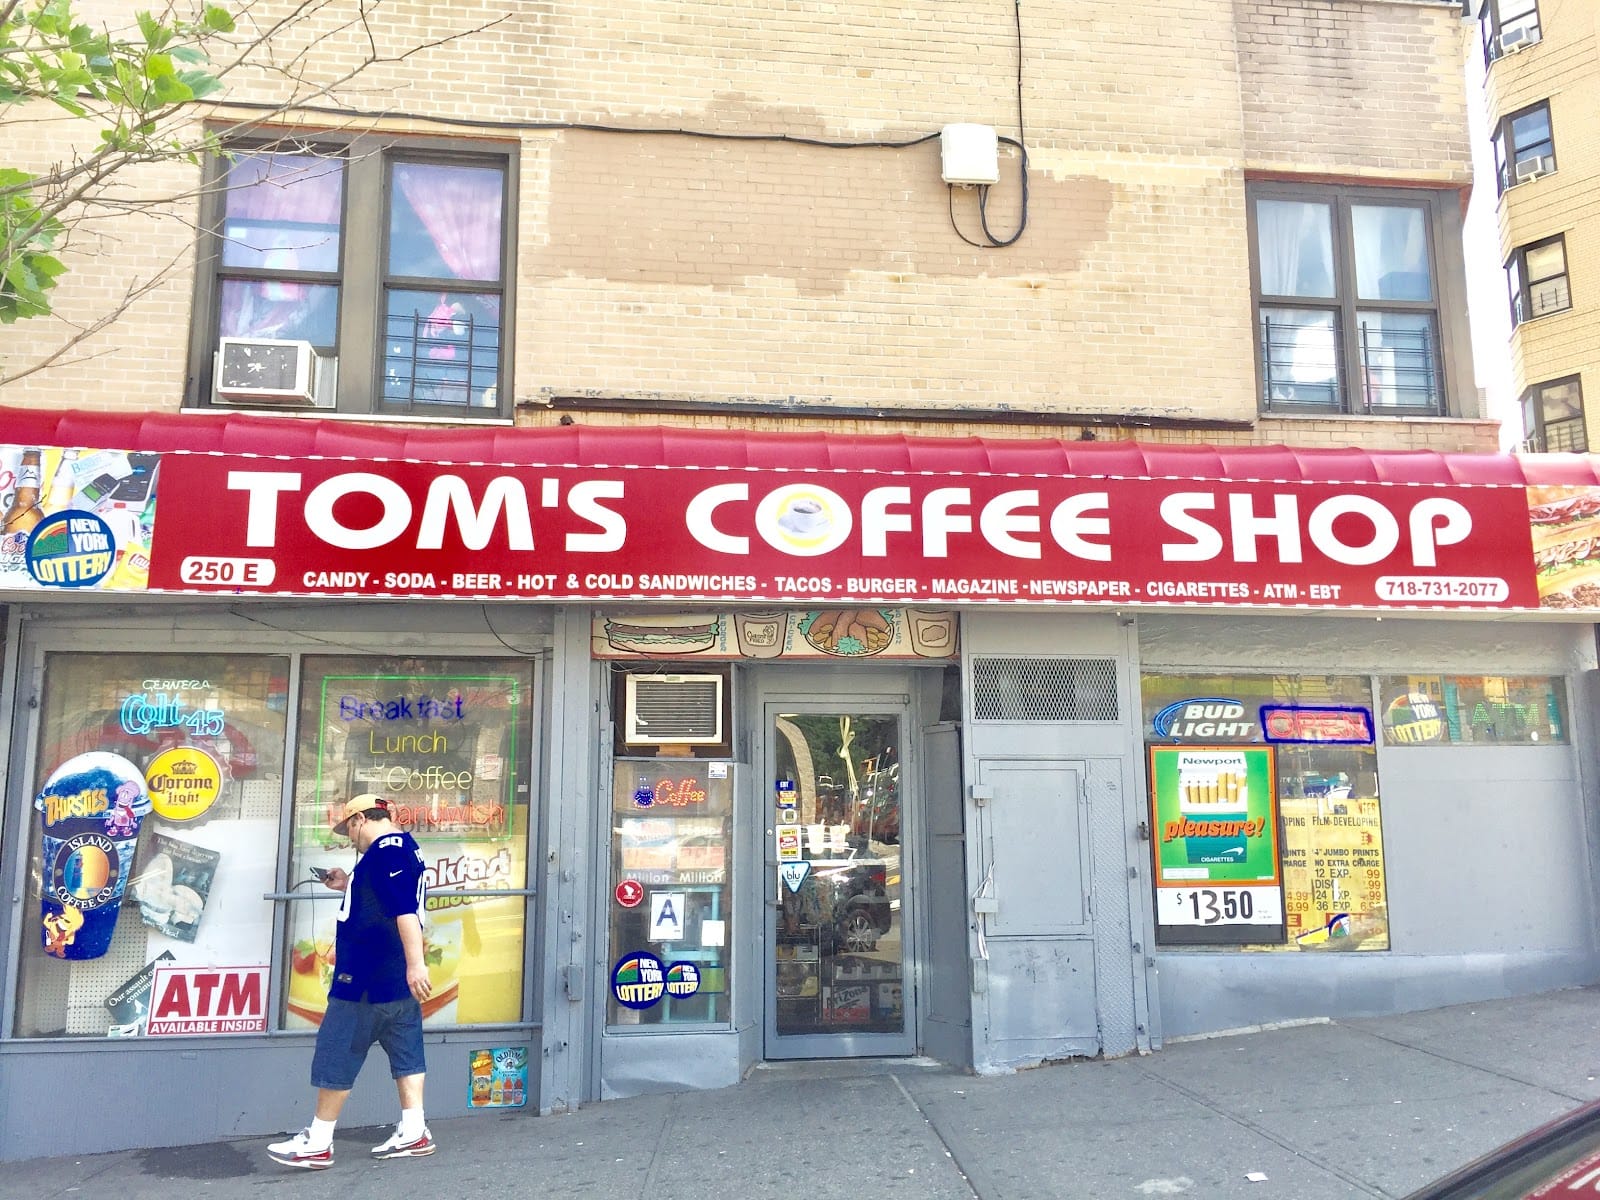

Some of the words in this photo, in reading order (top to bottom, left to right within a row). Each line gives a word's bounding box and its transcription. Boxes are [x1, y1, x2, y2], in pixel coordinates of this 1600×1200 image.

[70, 518, 101, 533] NEW
[227, 471, 627, 553] TOM'S
[686, 483, 1112, 562] COFFEE
[1160, 492, 1473, 567] SHOP
[72, 533, 110, 553] YORK
[32, 551, 113, 582] LOTTERY
[188, 560, 235, 582] 250
[243, 563, 259, 583] E
[303, 571, 370, 588] CANDY
[384, 573, 436, 589] SODA
[452, 574, 502, 590] BEER
[518, 574, 557, 590] HOT
[566, 574, 580, 590] &
[585, 574, 634, 590] COLD
[638, 575, 757, 591] SANDWICHES
[775, 577, 832, 592] TACOS
[847, 578, 917, 593] BURGER
[932, 579, 1018, 595] MAGAZINE
[1146, 582, 1250, 598] CIGARETTES
[1263, 583, 1298, 599] ATM
[1310, 584, 1341, 599] EBT
[1385, 581, 1498, 597] 718-731-2077
[1408, 692, 1430, 704] NEW
[1184, 704, 1245, 719] BUD
[1411, 703, 1438, 719] YORK
[1471, 703, 1541, 727] ATM
[186, 709, 225, 736] 45
[1169, 722, 1255, 737] LIGHT
[1266, 711, 1367, 739] OPEN
[369, 730, 447, 754] Lunch
[1182, 757, 1243, 766] Newport
[147, 774, 213, 794] Corona
[386, 765, 473, 792] Coffee
[655, 778, 707, 807] Coffee
[1164, 815, 1265, 842] pleasure!
[1312, 815, 1330, 826] FILM
[1333, 816, 1379, 827] DEVELOPING
[67, 835, 114, 853] ISLAND
[1323, 849, 1350, 857] JUMBO
[1352, 849, 1380, 857] PRINTS
[1327, 859, 1350, 867] EXTRA
[1352, 859, 1381, 868] CHARGE
[679, 870, 723, 883] Million
[786, 869, 801, 880] blu
[1314, 868, 1326, 878] 12
[57, 886, 97, 909] COFFEE
[1315, 890, 1328, 900] 24
[656, 898, 679, 927] A
[1315, 901, 1329, 911] 36
[639, 958, 659, 970] NEW
[640, 968, 664, 983] YORK
[155, 972, 262, 1018] ATM
[616, 982, 665, 1003] LOTTERY
[666, 981, 699, 995] LOTTERY
[108, 991, 126, 1007] Our
[150, 1019, 218, 1034] AVAILABLE
[220, 1018, 263, 1033] INSIDE
